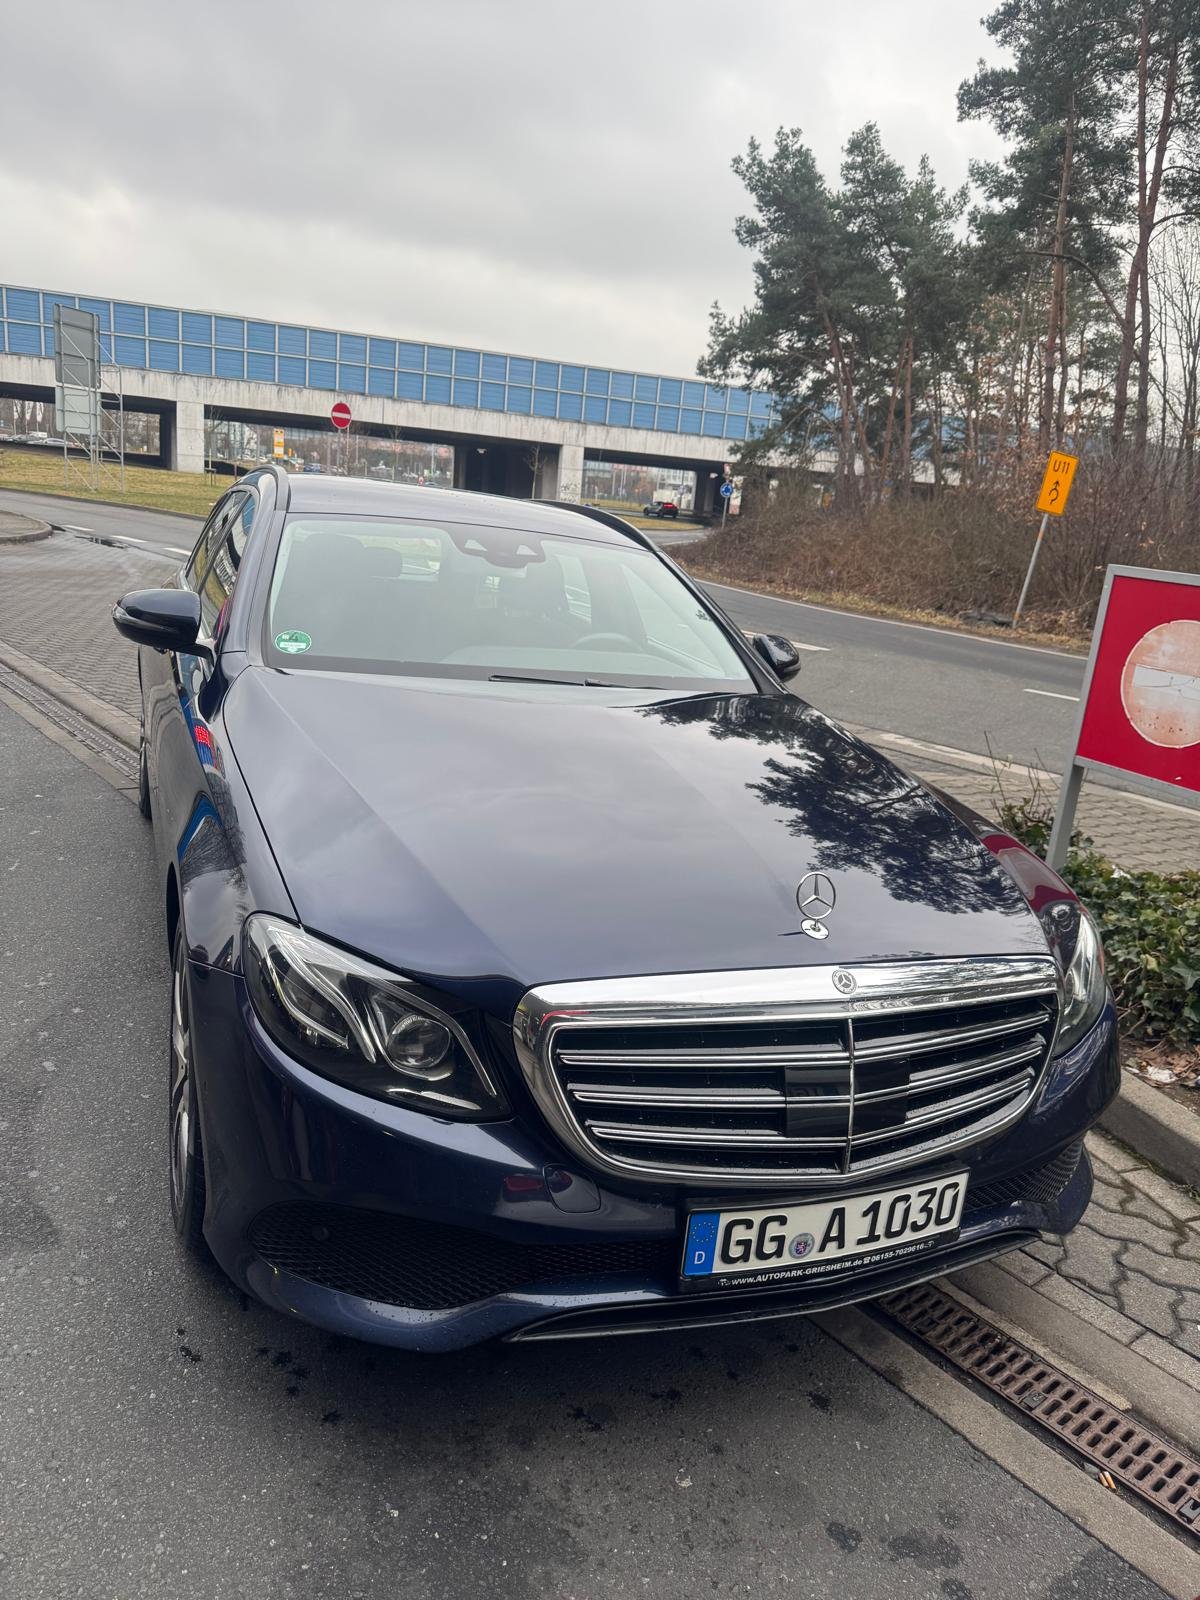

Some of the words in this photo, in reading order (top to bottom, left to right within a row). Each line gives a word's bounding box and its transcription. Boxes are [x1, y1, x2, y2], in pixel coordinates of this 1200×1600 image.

[1053, 460, 1070, 474] U11
[720, 1214, 788, 1264] GG
[817, 1206, 846, 1253] A
[855, 1181, 960, 1246] 1030
[694, 1251, 706, 1264] D
[732, 1258, 862, 1285] www.AUTOPARK-GRIESHEIM.de
